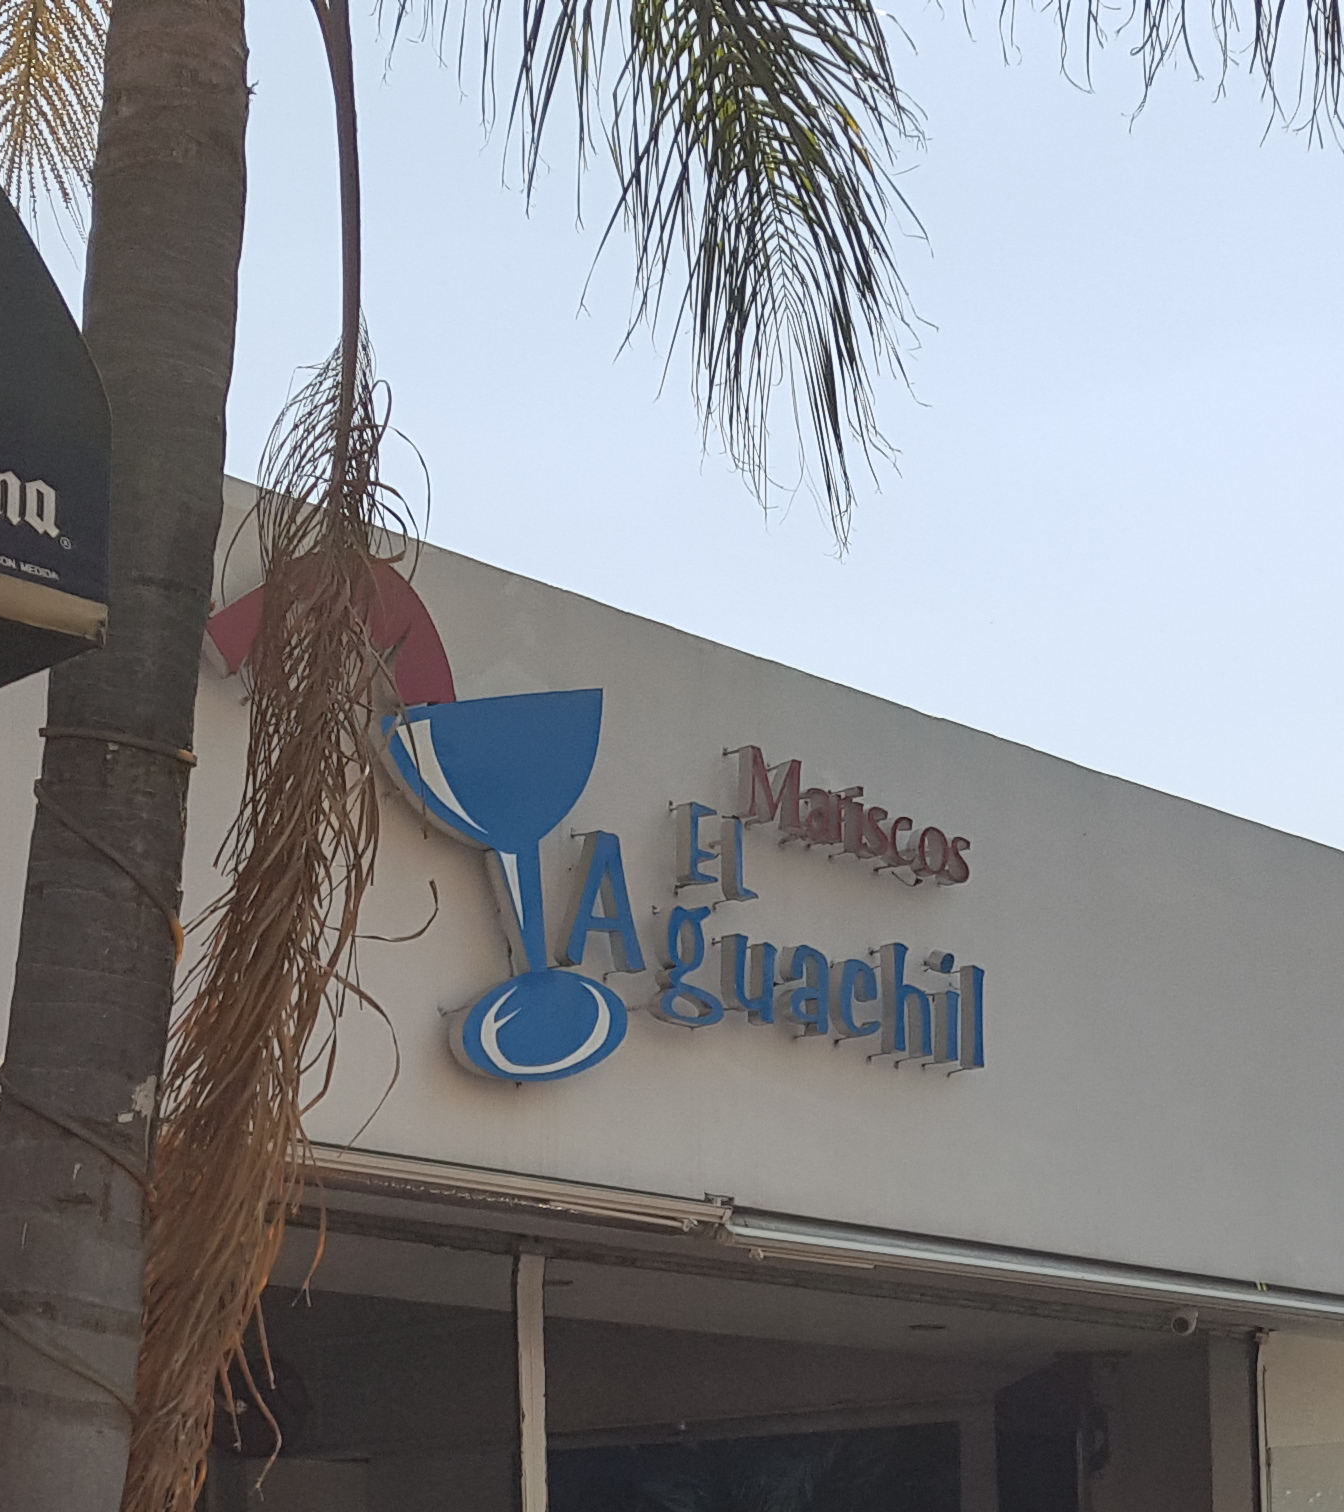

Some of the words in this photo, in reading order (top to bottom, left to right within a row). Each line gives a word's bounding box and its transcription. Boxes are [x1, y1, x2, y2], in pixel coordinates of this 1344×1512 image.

[19, 561, 59, 580] MEDIDA
[737, 744, 972, 885] Mariscos
[557, 829, 986, 1070] Aguachil
